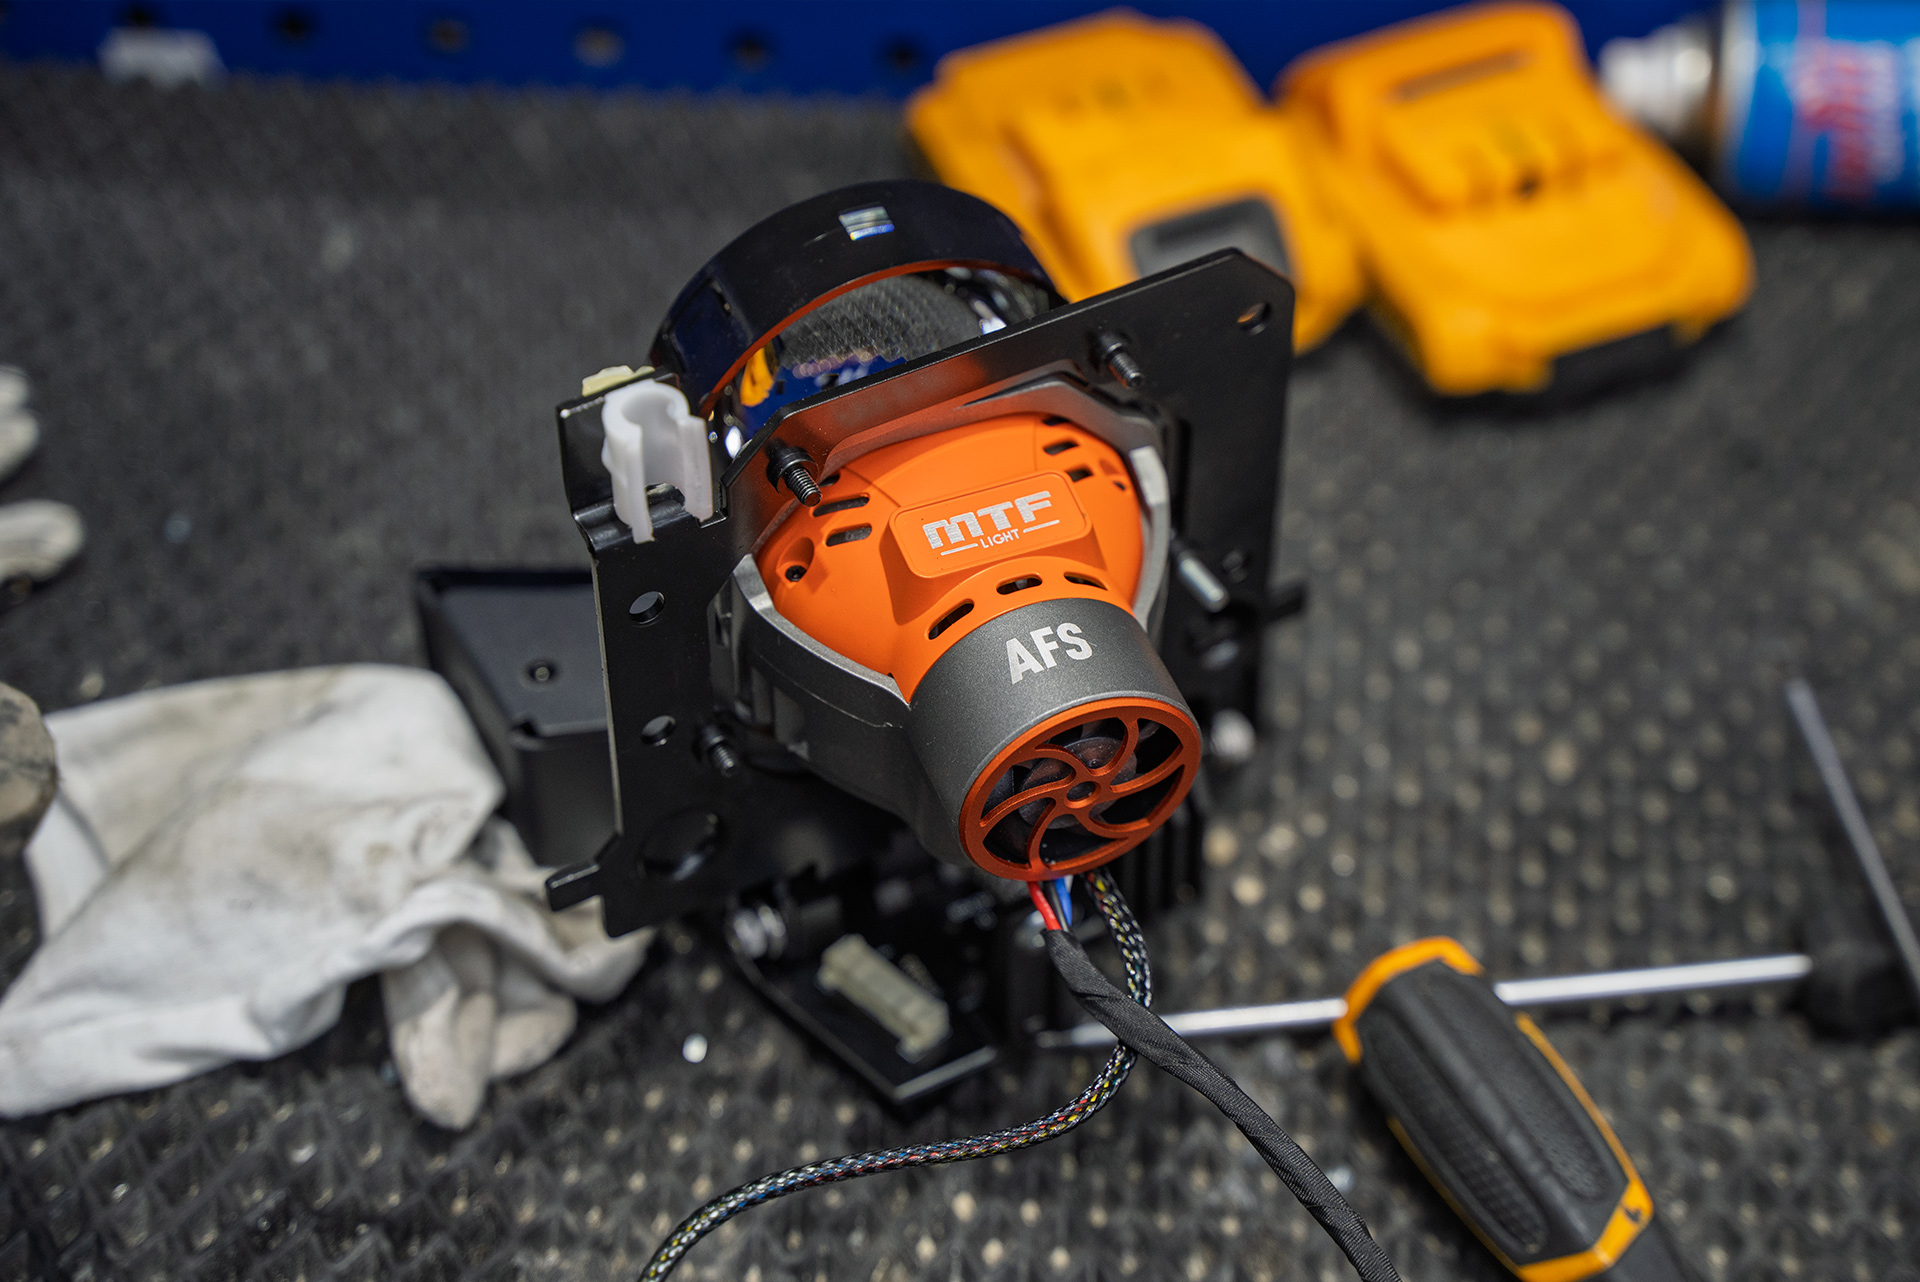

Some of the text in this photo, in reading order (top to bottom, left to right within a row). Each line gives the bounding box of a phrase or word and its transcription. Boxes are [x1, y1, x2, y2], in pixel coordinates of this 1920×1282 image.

[923, 490, 1052, 549] MTF
[980, 529, 1020, 549] LIGHT
[1005, 622, 1093, 684] AFS
